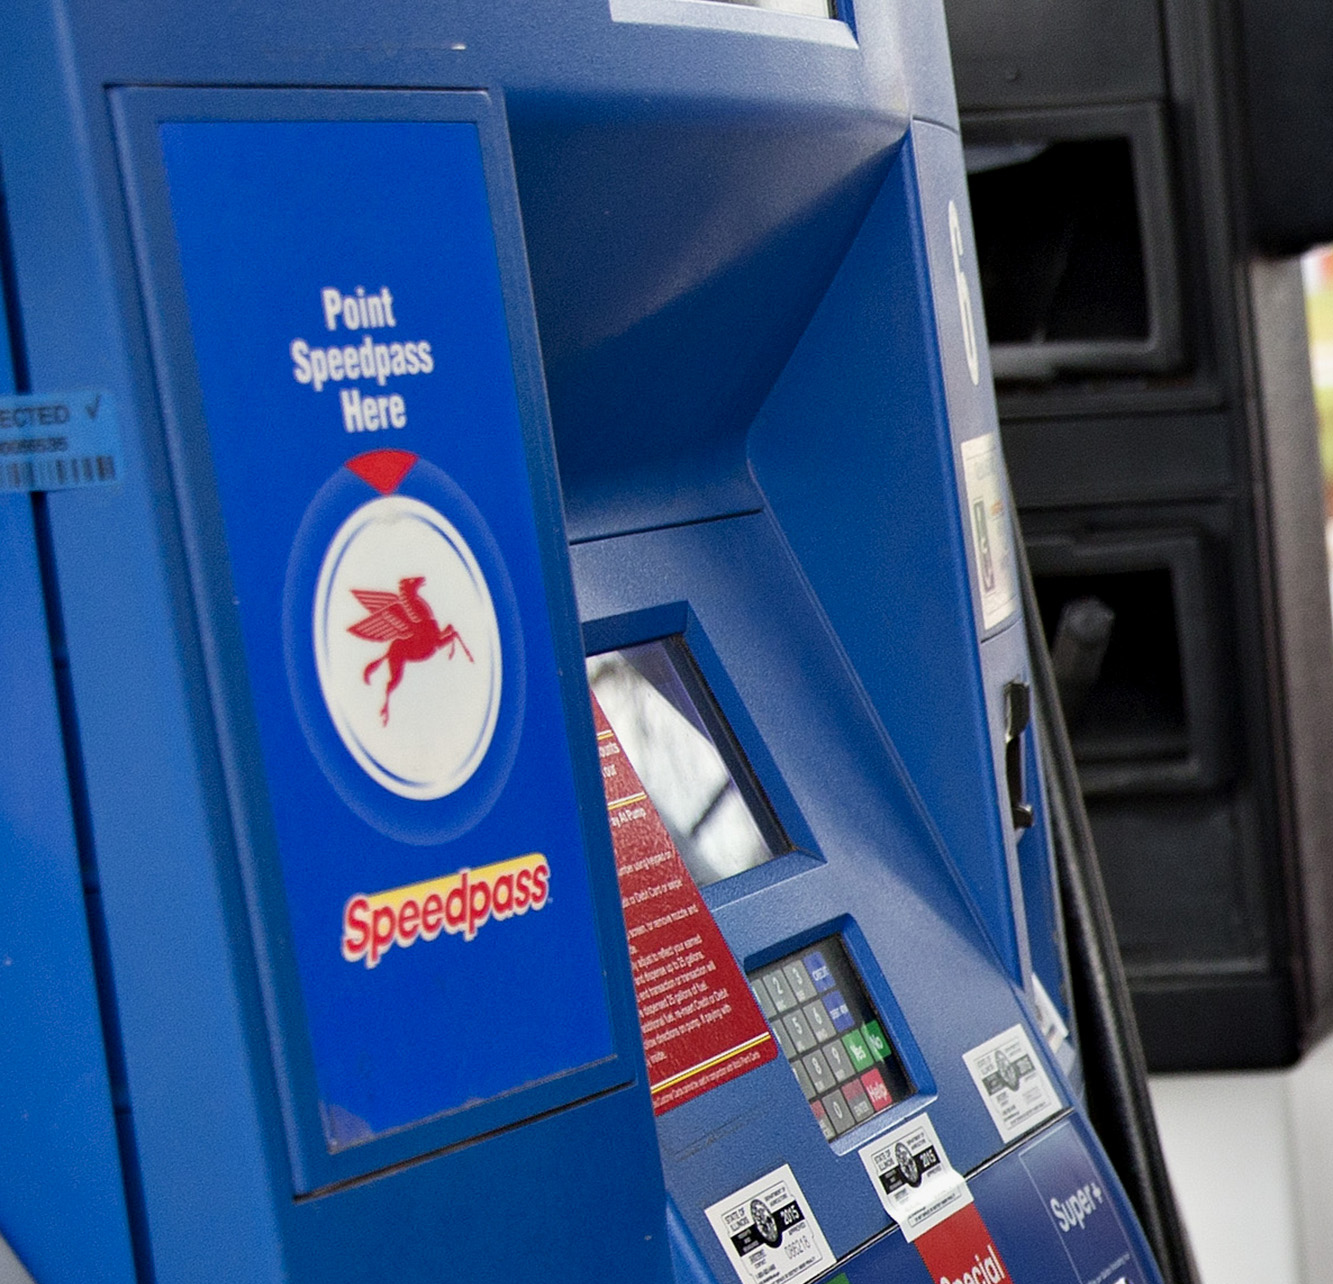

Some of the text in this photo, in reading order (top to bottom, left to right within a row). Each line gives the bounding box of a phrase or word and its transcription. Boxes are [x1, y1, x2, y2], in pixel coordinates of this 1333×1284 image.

[322, 287, 396, 330] Point
[291, 337, 434, 391] Speedpass
[341, 389, 407, 433] Here
[343, 862, 549, 963] Speedpass
[772, 977, 783, 995] 2
[792, 967, 803, 985] 3
[791, 1016, 803, 1035] 5
[812, 1006, 822, 1025] 6
[812, 1057, 822, 1075] 8
[831, 1047, 841, 1064] 9
[850, 1044, 866, 1061] Yes
[833, 1101, 843, 1119] 0
[866, 1082, 887, 1102] Help
[918, 1149, 937, 1166] 2015
[779, 1204, 800, 1224] 2015
[1051, 1182, 1103, 1233] Super+
